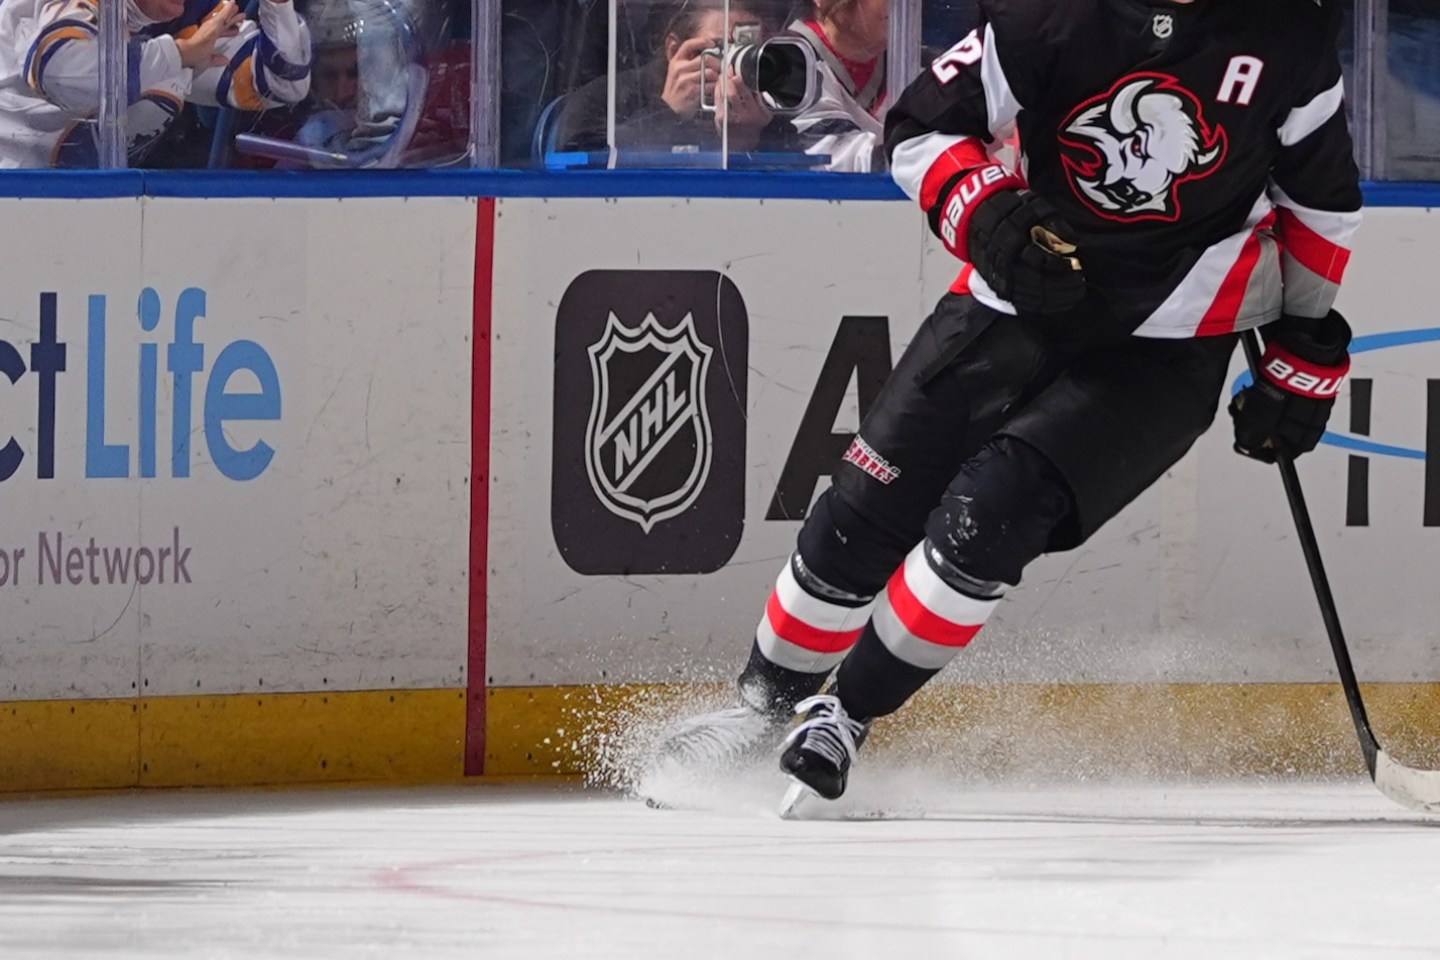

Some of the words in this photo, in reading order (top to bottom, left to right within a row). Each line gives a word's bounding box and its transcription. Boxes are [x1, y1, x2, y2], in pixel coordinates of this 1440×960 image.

[1215, 54, 1264, 106] A
[613, 369, 687, 482] NHL
[37, 526, 193, 587] Network
